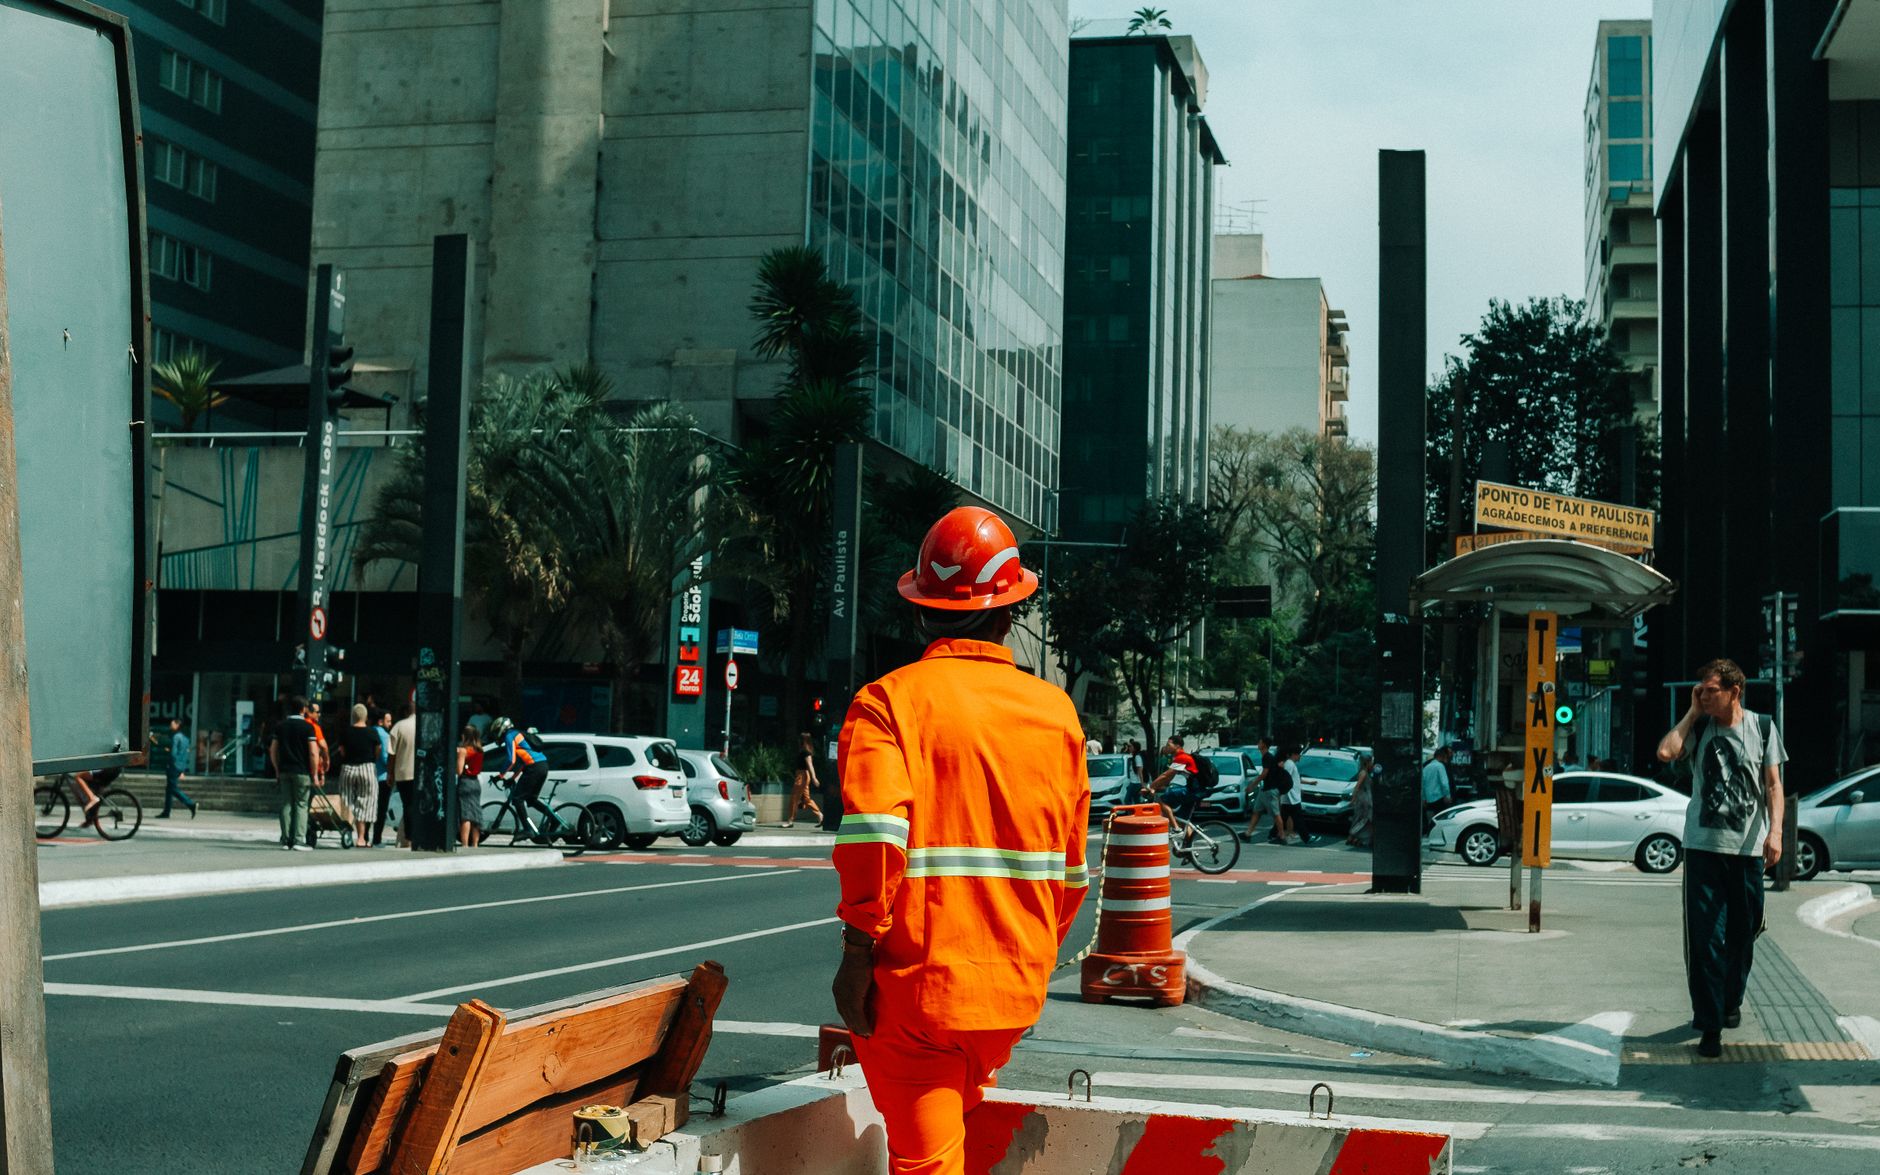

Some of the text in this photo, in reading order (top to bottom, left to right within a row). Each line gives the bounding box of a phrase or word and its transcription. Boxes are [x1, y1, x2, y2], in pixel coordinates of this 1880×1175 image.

[312, 421, 334, 606] R. Haddock Lobo
[1481, 487, 1650, 528] PONTO DE TAXI PAULISTA
[1482, 507, 1565, 530] AGRADECEMOS
[1569, 521, 1577, 531] A
[833, 530, 847, 618] Av. Paulista
[681, 591, 690, 623] Drogaria
[680, 669, 700, 685] 24
[1531, 619, 1548, 857] TAXI
[1102, 963, 1169, 987] CTS
